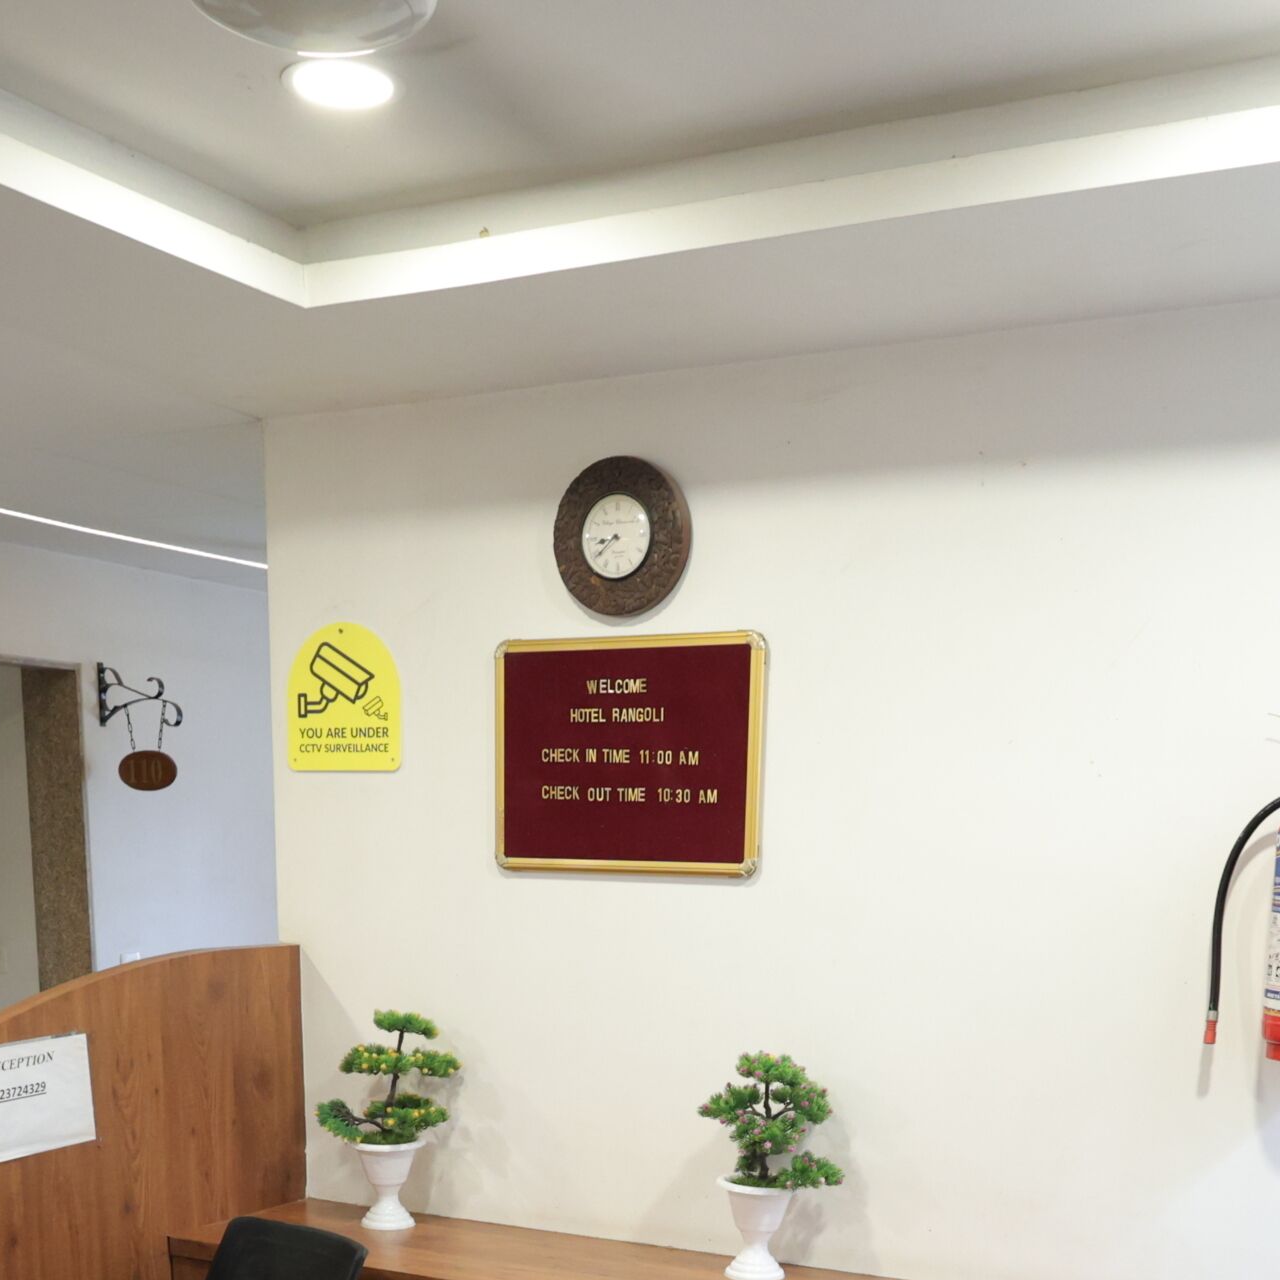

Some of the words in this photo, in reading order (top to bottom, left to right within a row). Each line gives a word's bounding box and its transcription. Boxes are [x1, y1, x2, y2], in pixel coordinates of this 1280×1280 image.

[587, 677, 648, 695] WELCOME
[570, 708, 606, 724] HOTEL
[612, 707, 665, 723] RANGOLI
[299, 727, 322, 740] YOU
[325, 727, 348, 740] ARE
[351, 726, 389, 739] UNDER
[299, 743, 322, 754] CCTV
[324, 742, 389, 754] SURVEILLANCE
[541, 748, 580, 763] CHECK
[585, 748, 597, 764] IN
[602, 748, 631, 764] TIME
[639, 749, 673, 765] 11:00
[679, 750, 700, 766] AM
[541, 785, 580, 801] CHECK
[588, 786, 611, 802] OUT
[617, 787, 646, 803] TIME
[657, 788, 691, 804] 10:30
[699, 789, 718, 805] AM
